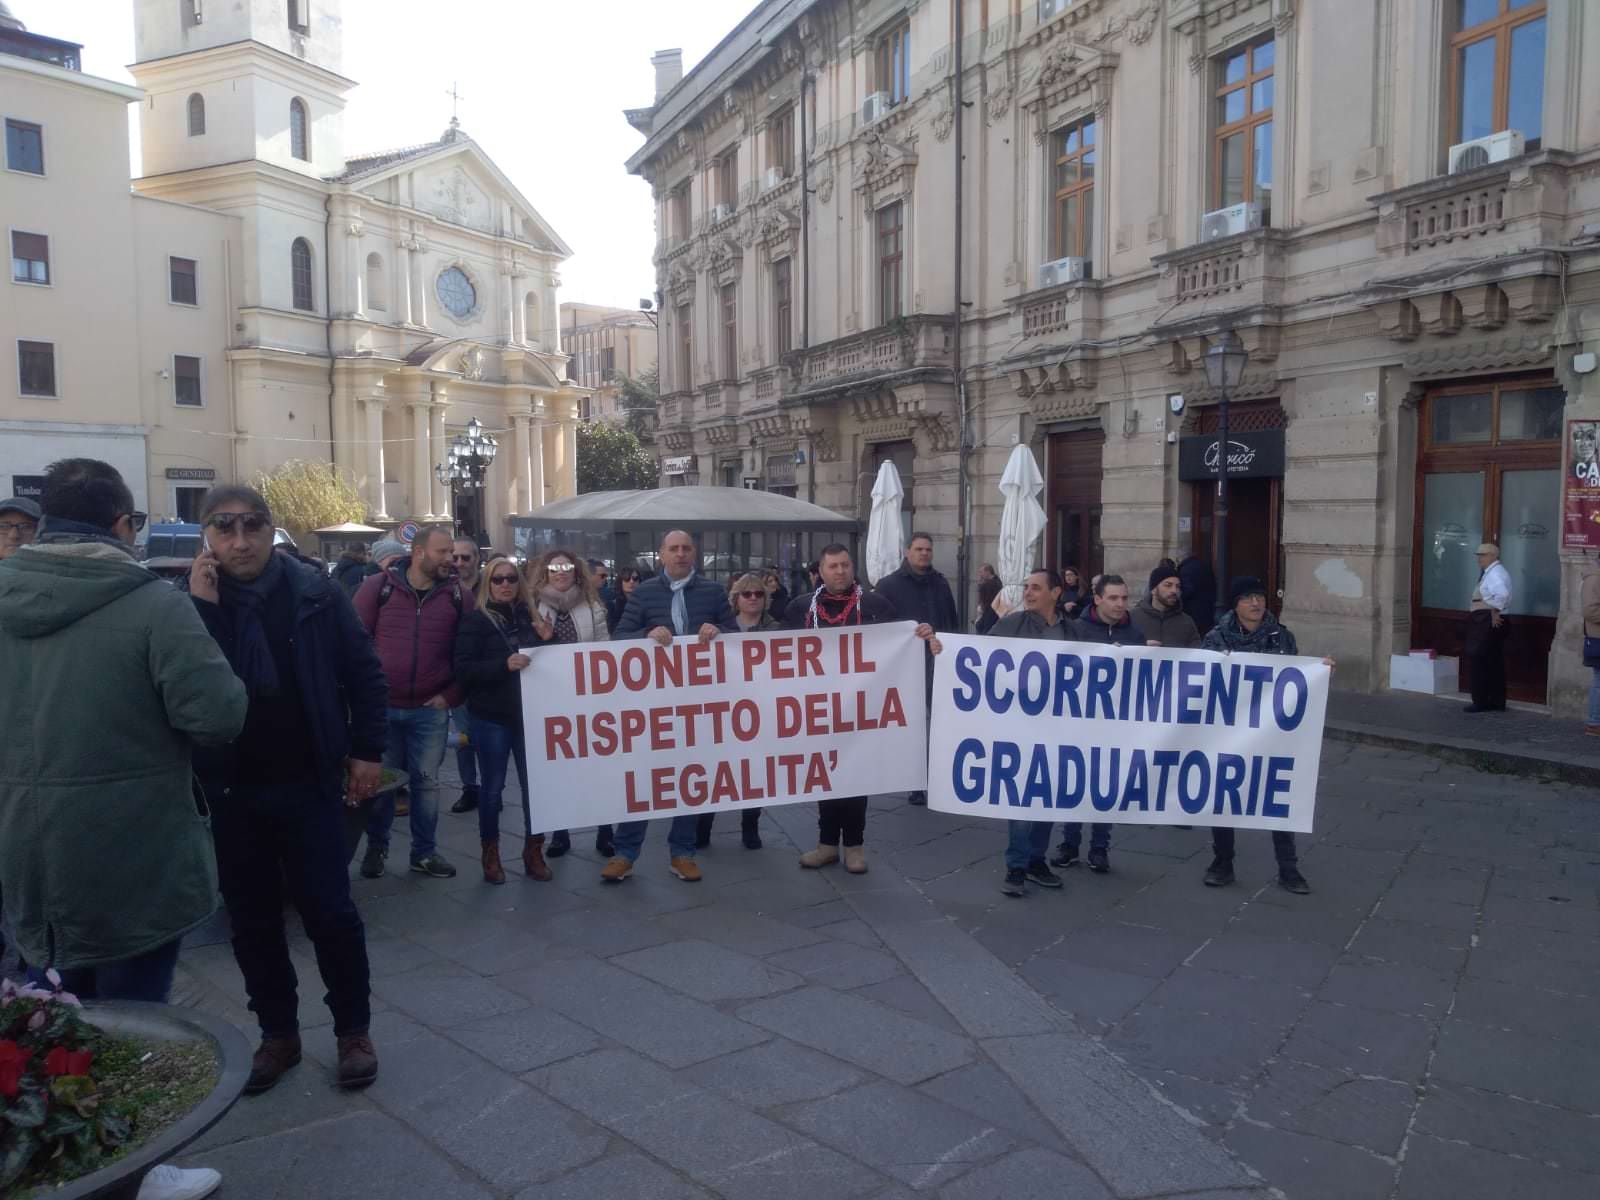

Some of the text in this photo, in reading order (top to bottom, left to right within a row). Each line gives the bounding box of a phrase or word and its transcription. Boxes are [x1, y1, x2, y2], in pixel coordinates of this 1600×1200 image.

[574, 632, 876, 696] IDONEI PER IL
[952, 646, 1309, 731] SCORRIMENTO
[544, 687, 908, 761] RISPETTO DELLA
[952, 738, 1296, 818] GRADUATORIE
